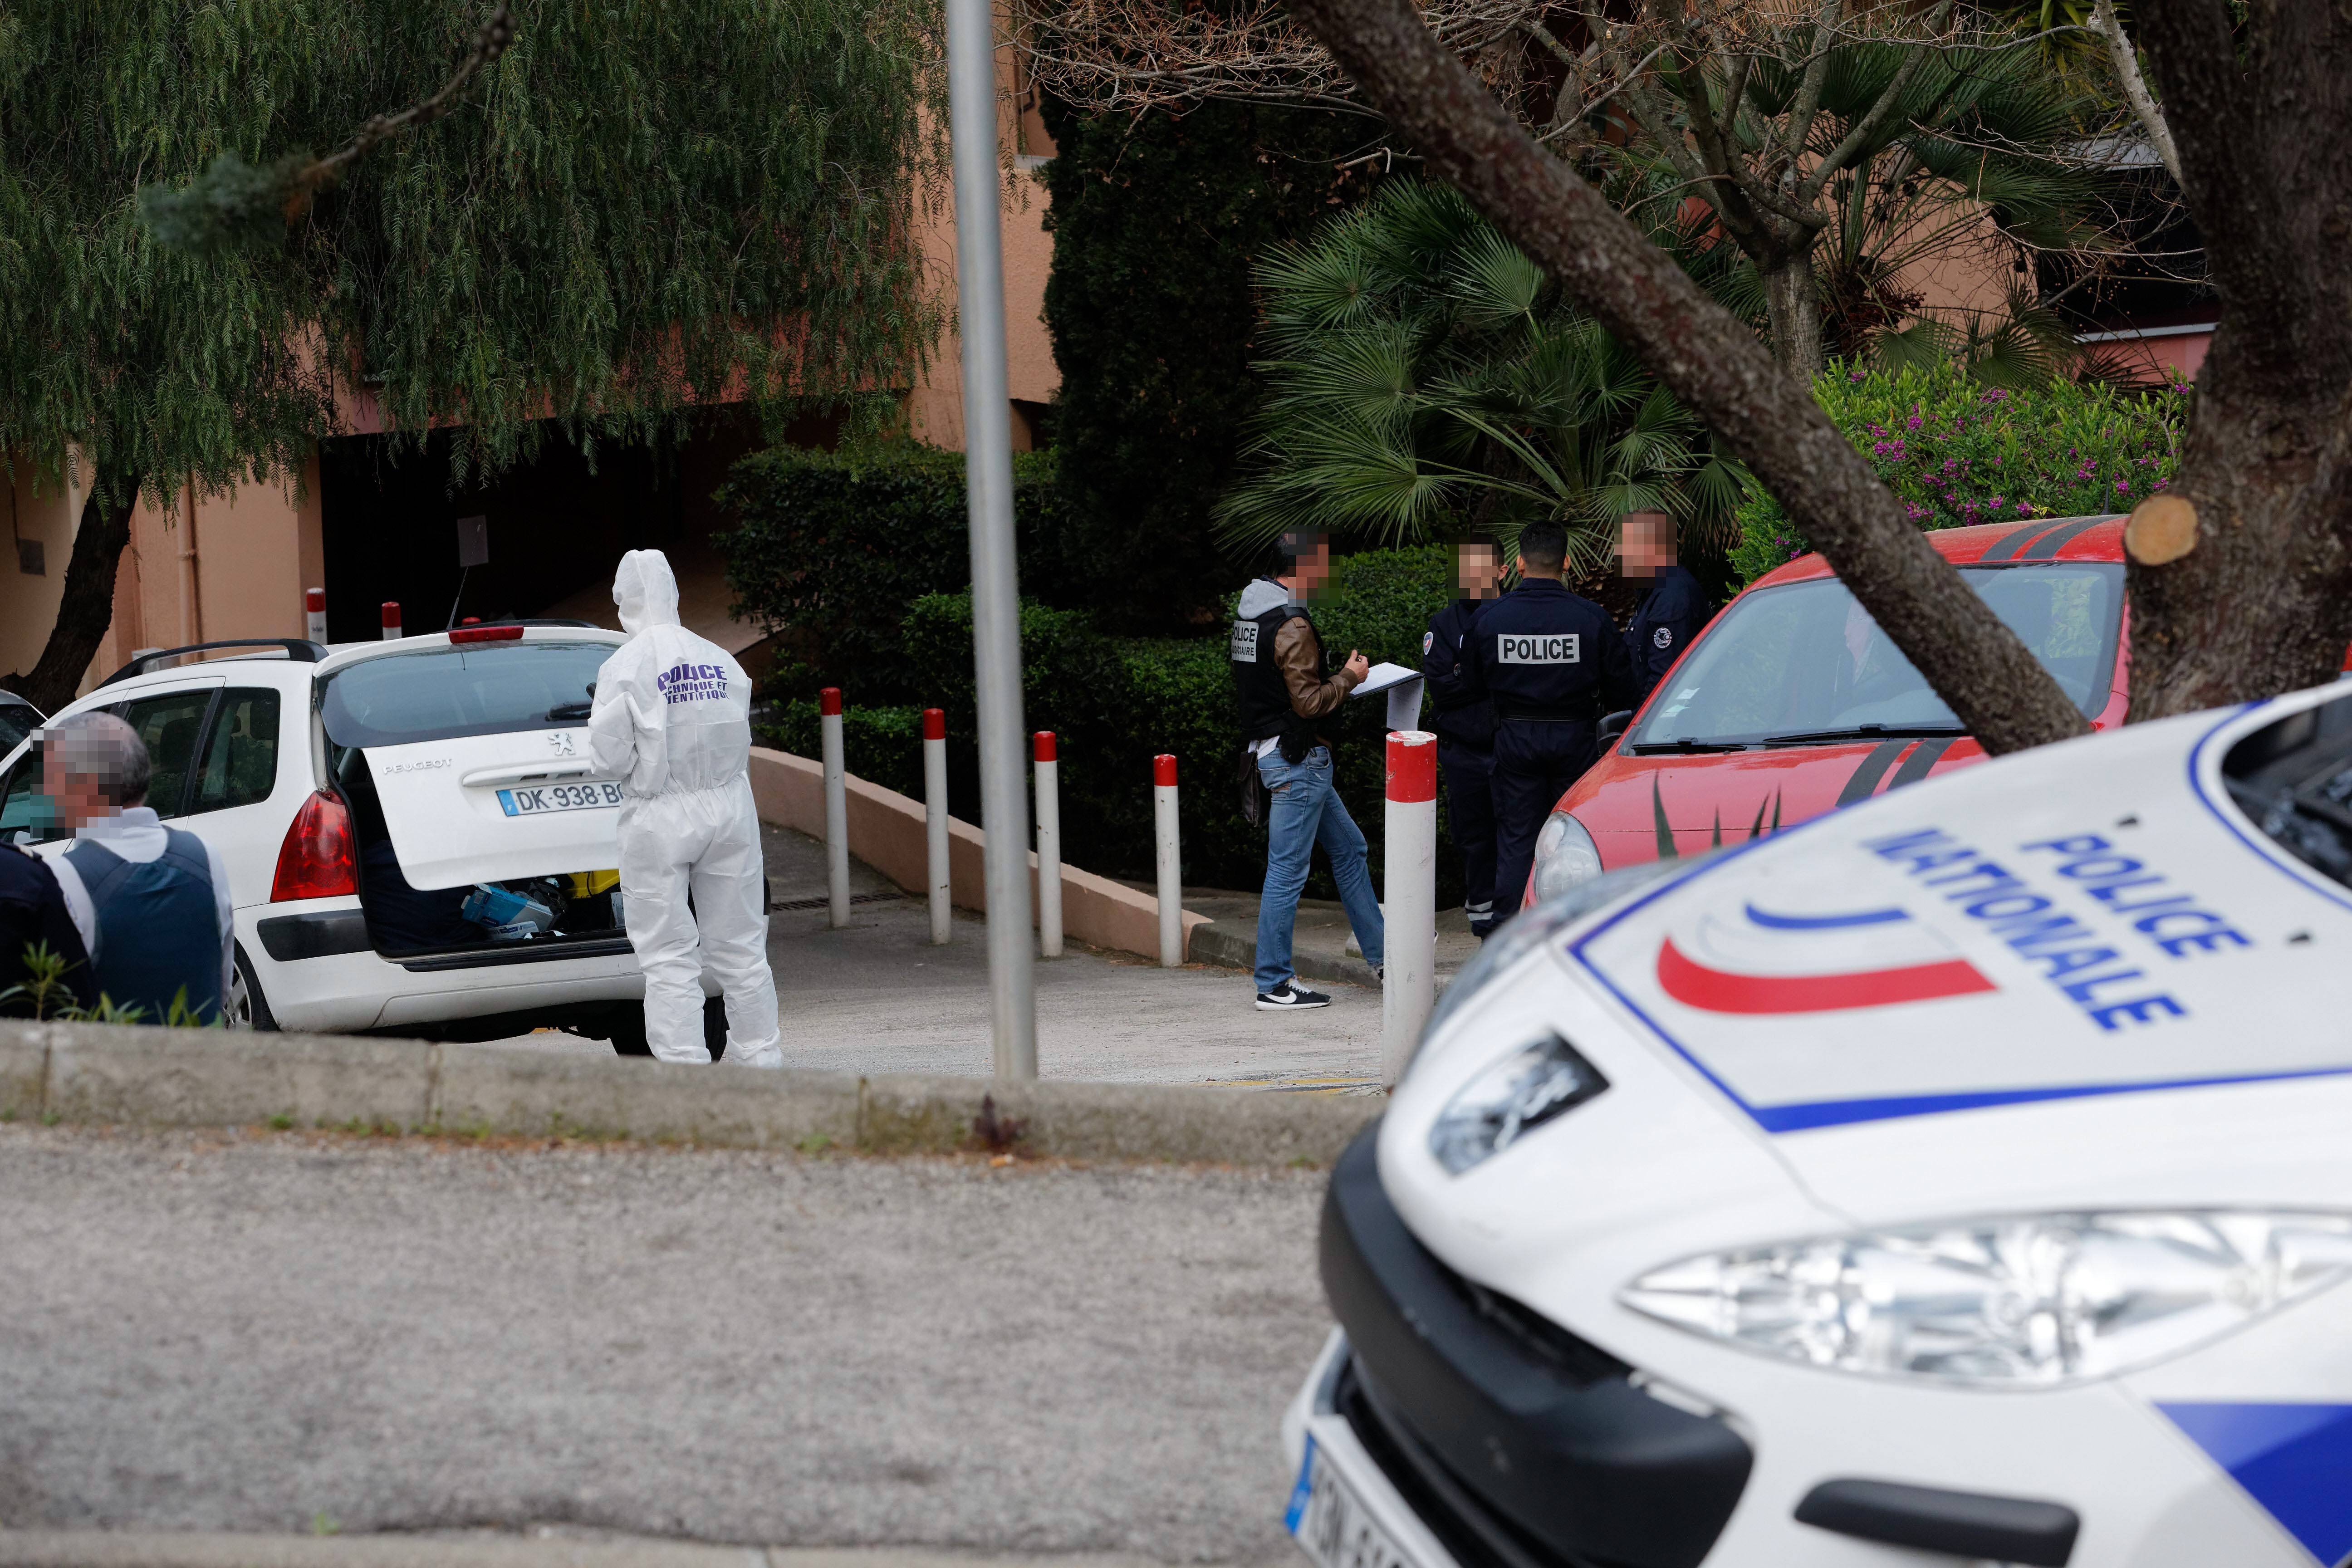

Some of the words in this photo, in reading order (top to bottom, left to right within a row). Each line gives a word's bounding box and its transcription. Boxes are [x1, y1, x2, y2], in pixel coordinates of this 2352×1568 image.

[1503, 638, 1574, 660] POLICE
[657, 663, 727, 692] POLICE
[717, 681, 727, 691] ET
[382, 758, 452, 775] PEUGEOT
[2018, 833, 2255, 959] POLICE
[1858, 827, 2190, 1033] NATIONALE
